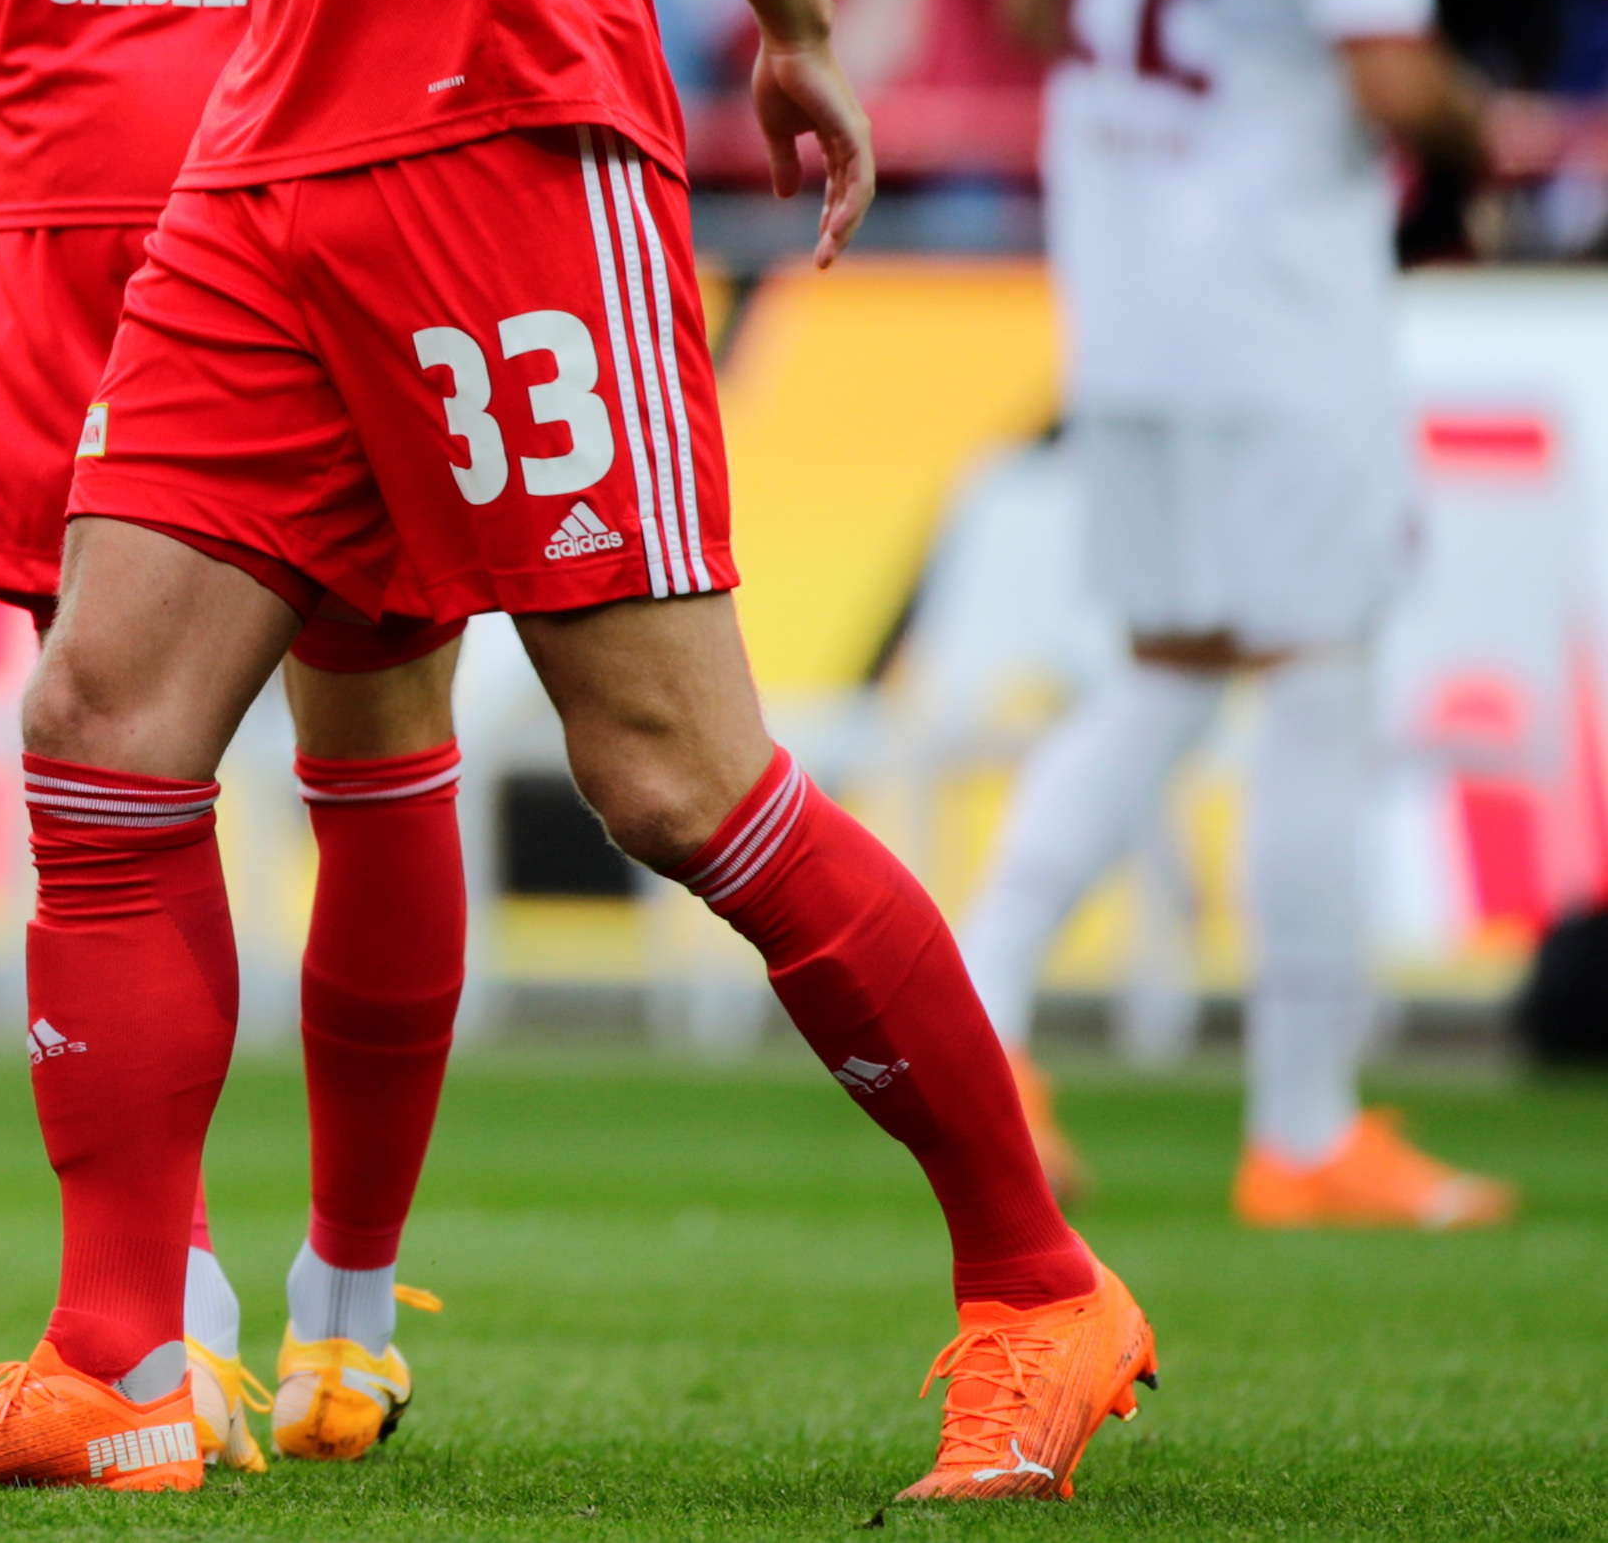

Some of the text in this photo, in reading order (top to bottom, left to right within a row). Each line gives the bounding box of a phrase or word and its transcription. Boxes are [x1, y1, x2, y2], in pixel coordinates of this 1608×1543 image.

[412, 309, 616, 506] 33
[544, 530, 624, 561] adidas
[86, 1421, 199, 1479] PUMA
